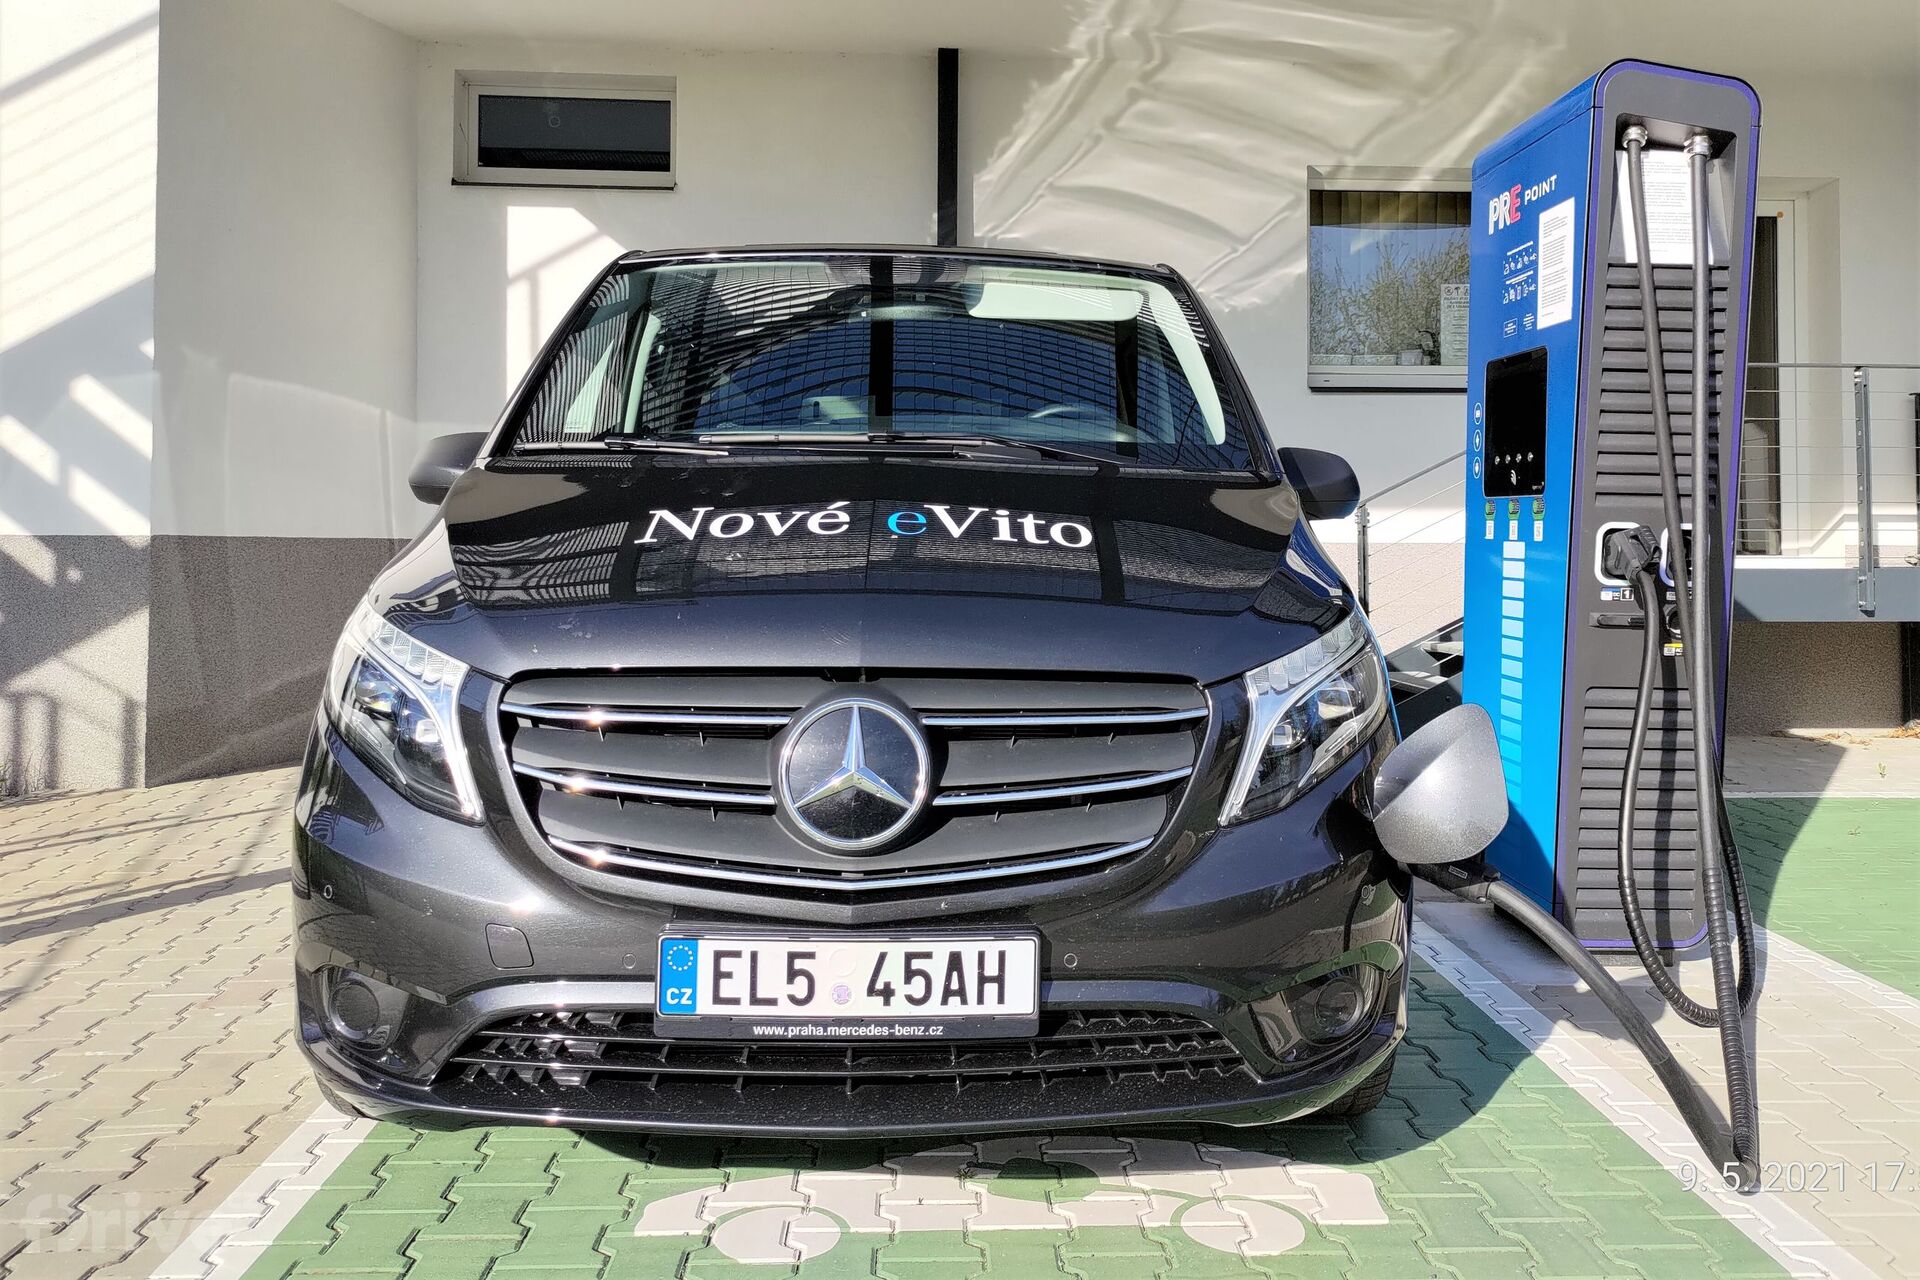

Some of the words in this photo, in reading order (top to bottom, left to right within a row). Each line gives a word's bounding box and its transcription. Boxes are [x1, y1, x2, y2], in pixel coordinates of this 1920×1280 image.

[1488, 184, 1522, 236] PRE
[1524, 174, 1558, 206] POINT
[634, 501, 851, 543] Nové
[888, 504, 1093, 548] eVito
[666, 986, 693, 1005] CZ
[711, 949, 817, 1007] EL5
[866, 950, 1007, 1007] 45AH
[752, 1023, 944, 1037] www.praha.mercedes-benz.cz
